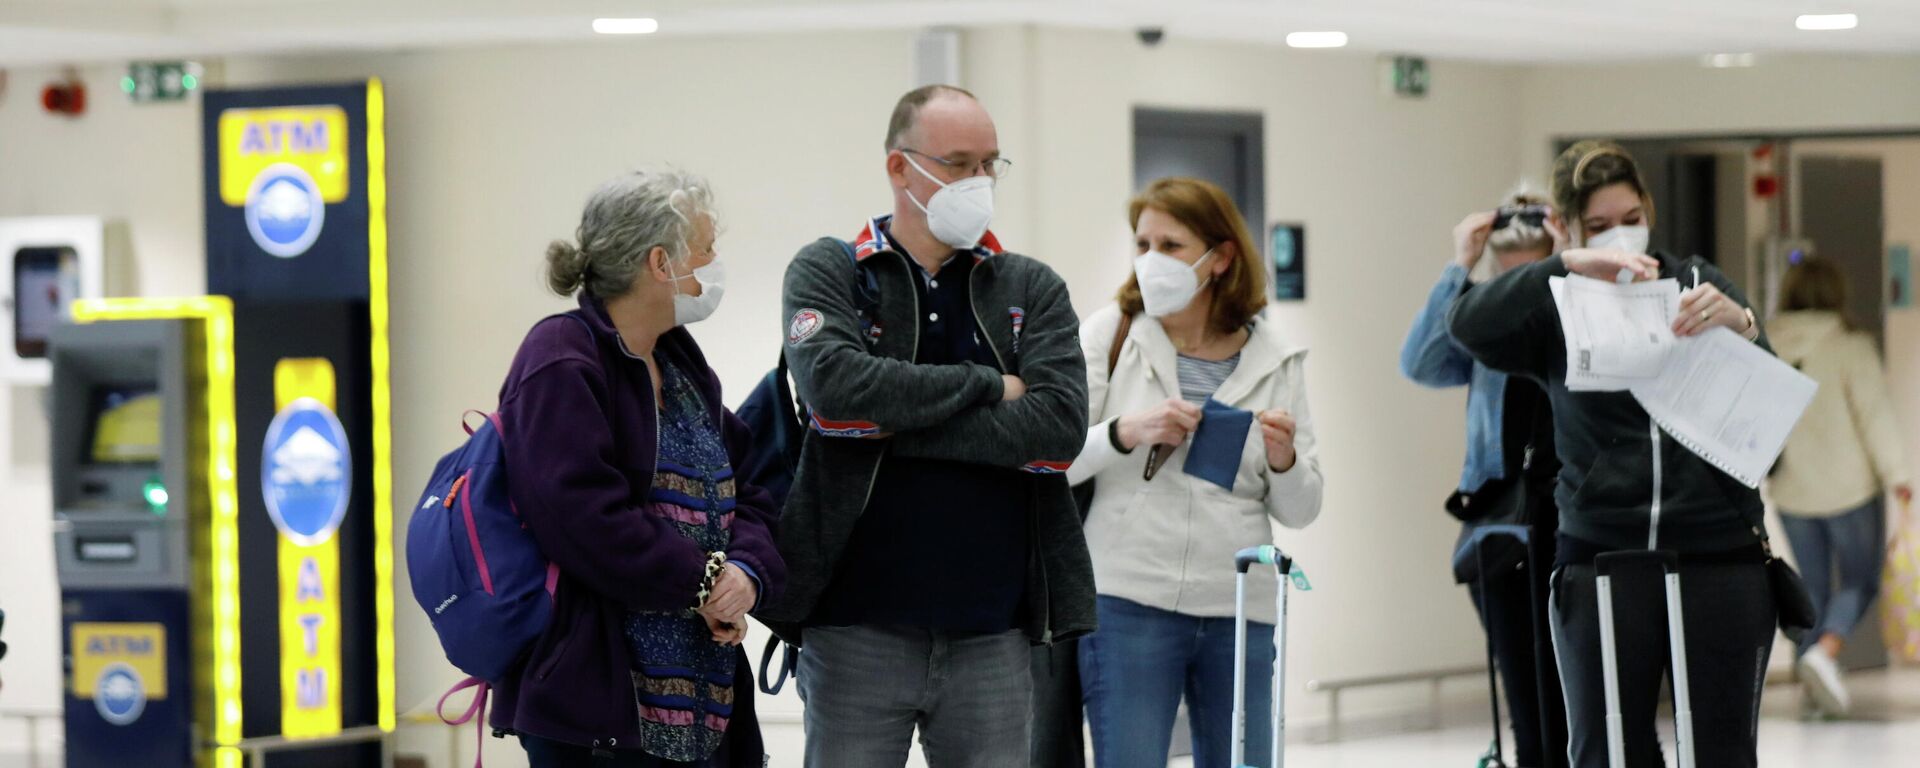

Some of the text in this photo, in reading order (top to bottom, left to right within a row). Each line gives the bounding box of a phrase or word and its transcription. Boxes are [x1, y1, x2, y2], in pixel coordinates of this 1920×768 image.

[241, 121, 329, 155] ATM
[86, 635, 154, 655] ATM
[296, 556, 328, 709] ATM
